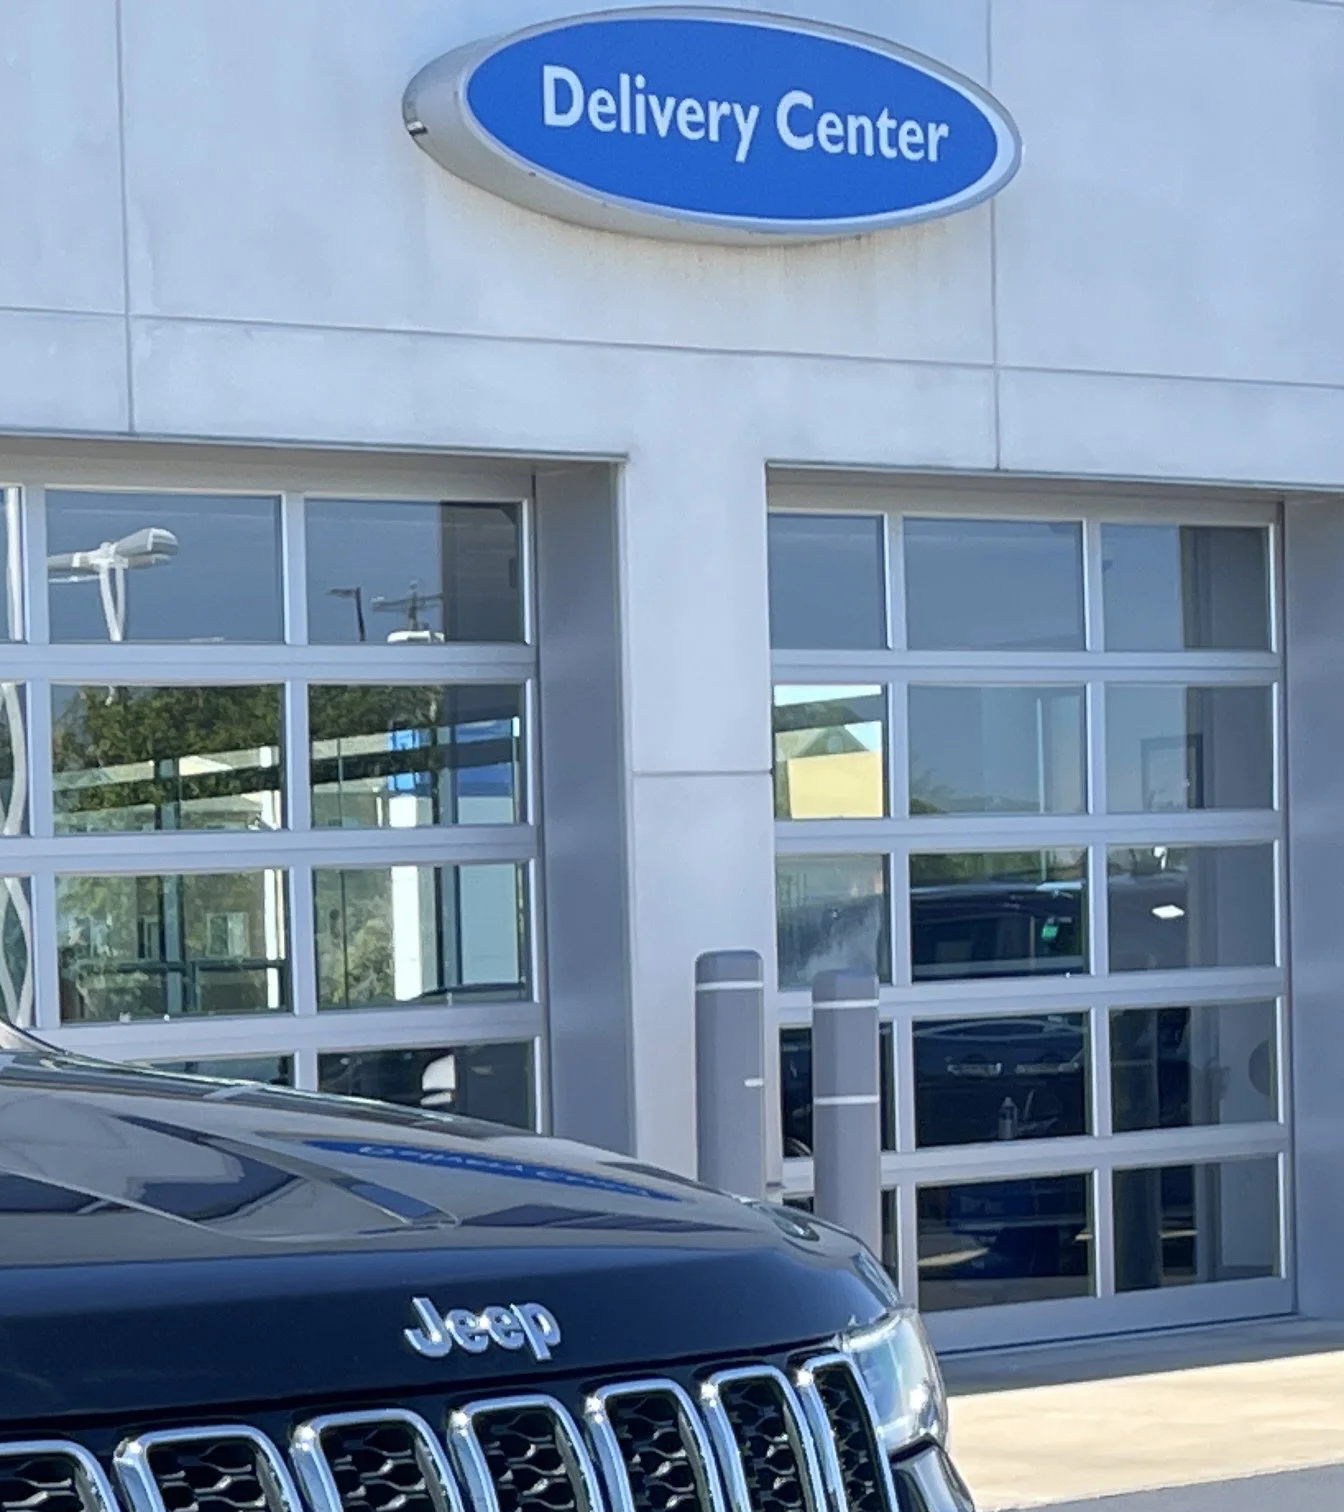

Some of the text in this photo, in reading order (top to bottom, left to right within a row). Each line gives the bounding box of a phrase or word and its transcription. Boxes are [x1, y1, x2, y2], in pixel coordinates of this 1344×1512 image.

[542, 65, 949, 163] Delivery Center
[404, 1297, 561, 1360] Jeep
